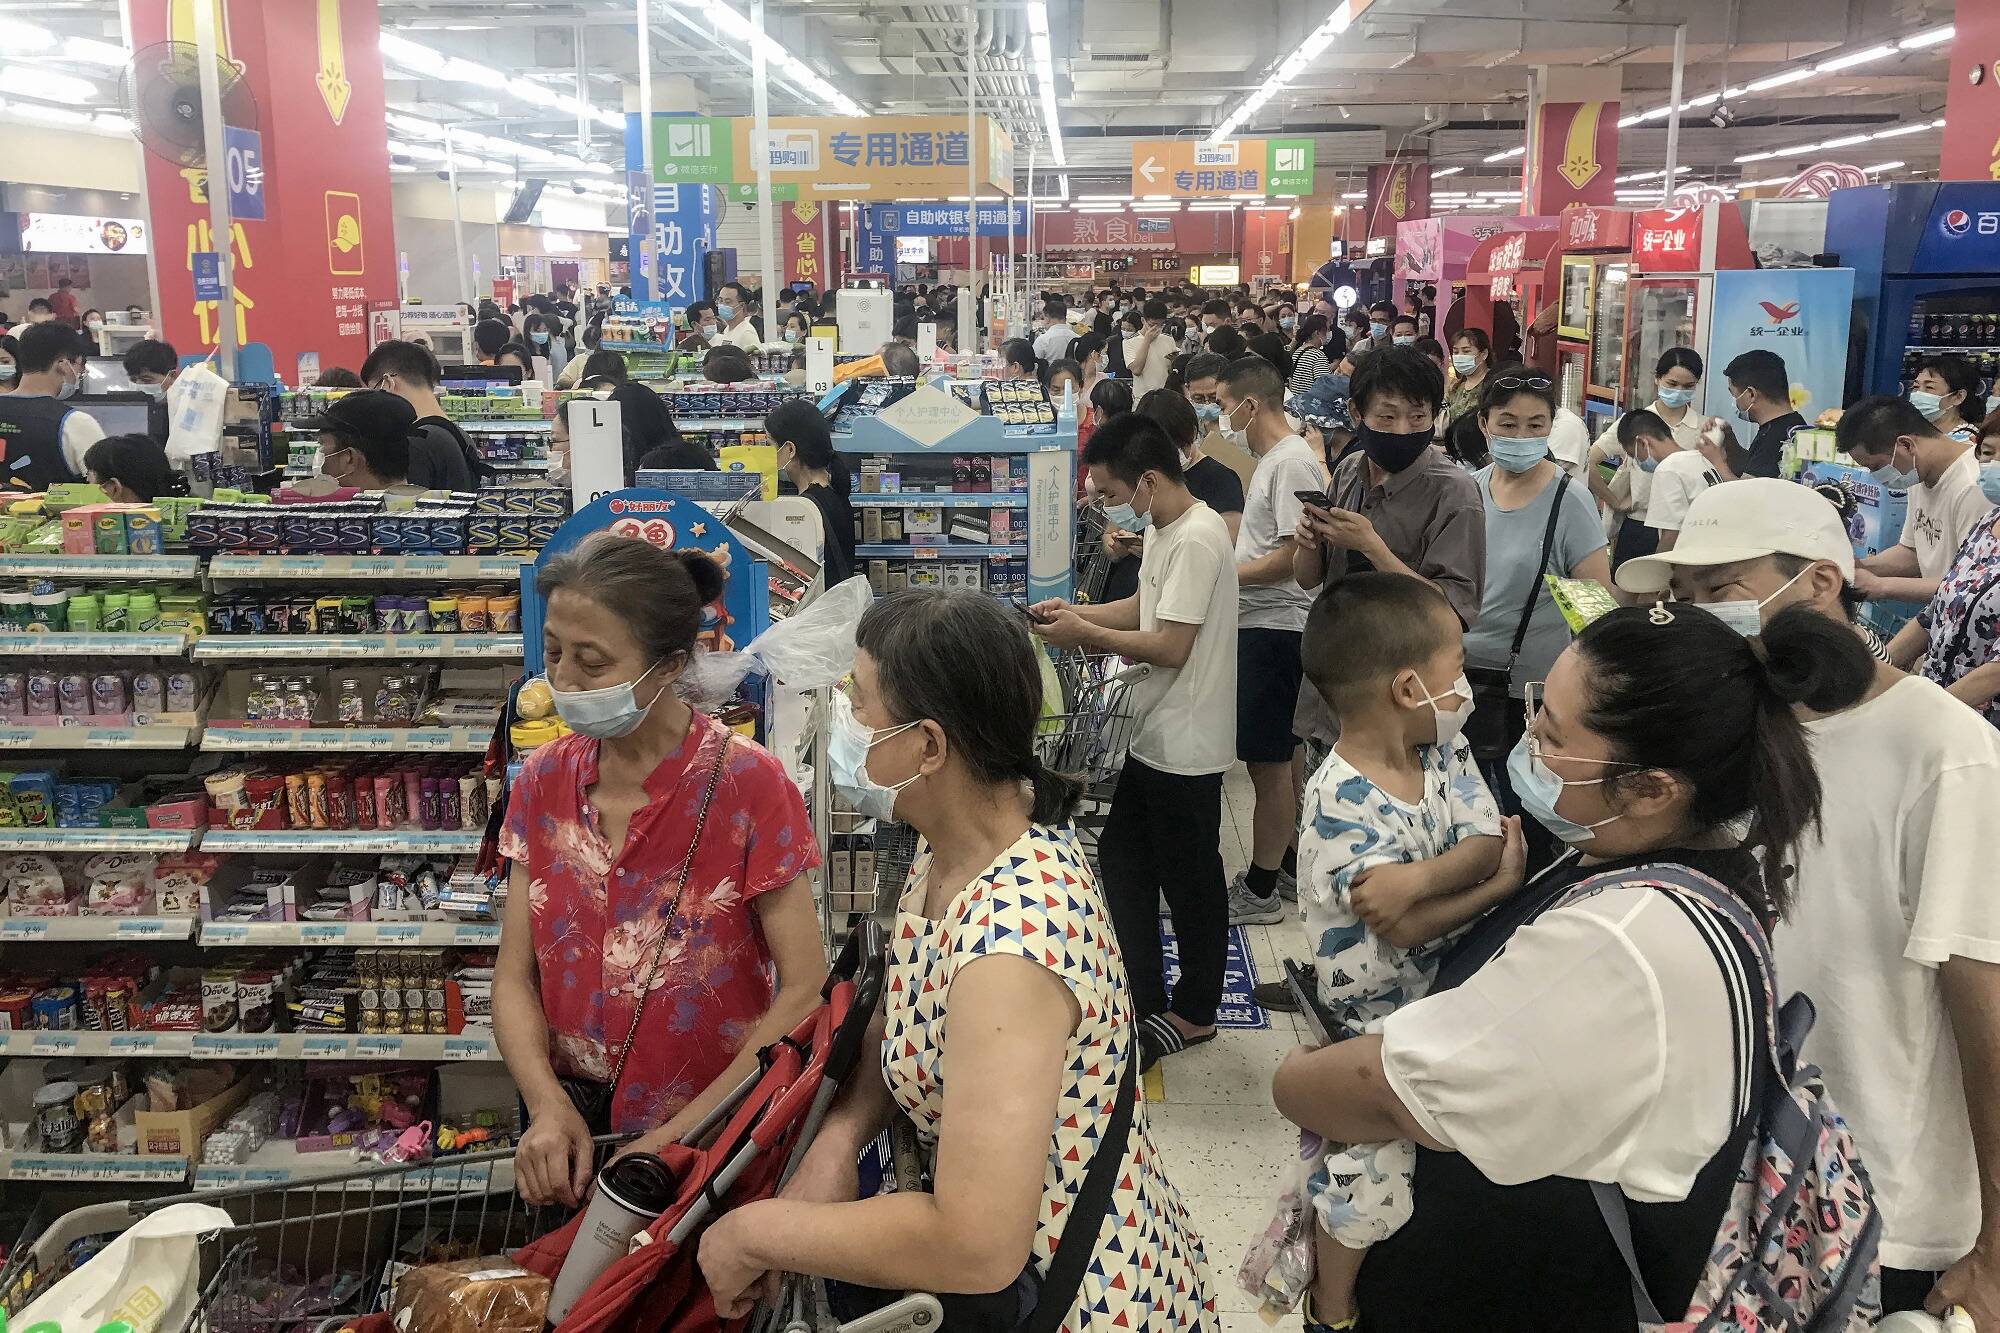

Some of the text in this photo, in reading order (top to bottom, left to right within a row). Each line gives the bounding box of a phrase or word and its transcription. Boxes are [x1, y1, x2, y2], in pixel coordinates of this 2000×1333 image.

[829, 131, 970, 168] 专用通道
[228, 147, 260, 196] 05
[1174, 170, 1259, 192] 专用通道
[1073, 216, 1129, 244] 熟食
[1133, 232, 1153, 243] Deli
[1642, 228, 1686, 252] 统一企业
[926, 325, 931, 333] L
[1750, 326, 1804, 336] 统一企业
[817, 340, 824, 351] L
[814, 382, 828, 391] 03
[593, 407, 604, 427] L
[896, 405, 963, 417] 个人护理中心
[1013, 467, 1028, 476] 003
[1047, 464, 1060, 542] 个人护理中心
[1013, 520, 1028, 529] 003
[993, 573, 1009, 582] 003
[1011, 573, 1027, 582] 003
[16, 861, 45, 873] Dove
[105, 855, 141, 868] Dove
[164, 878, 189, 888] Dove
[201, 985, 231, 997] Dove
[238, 987, 267, 999] Dove
